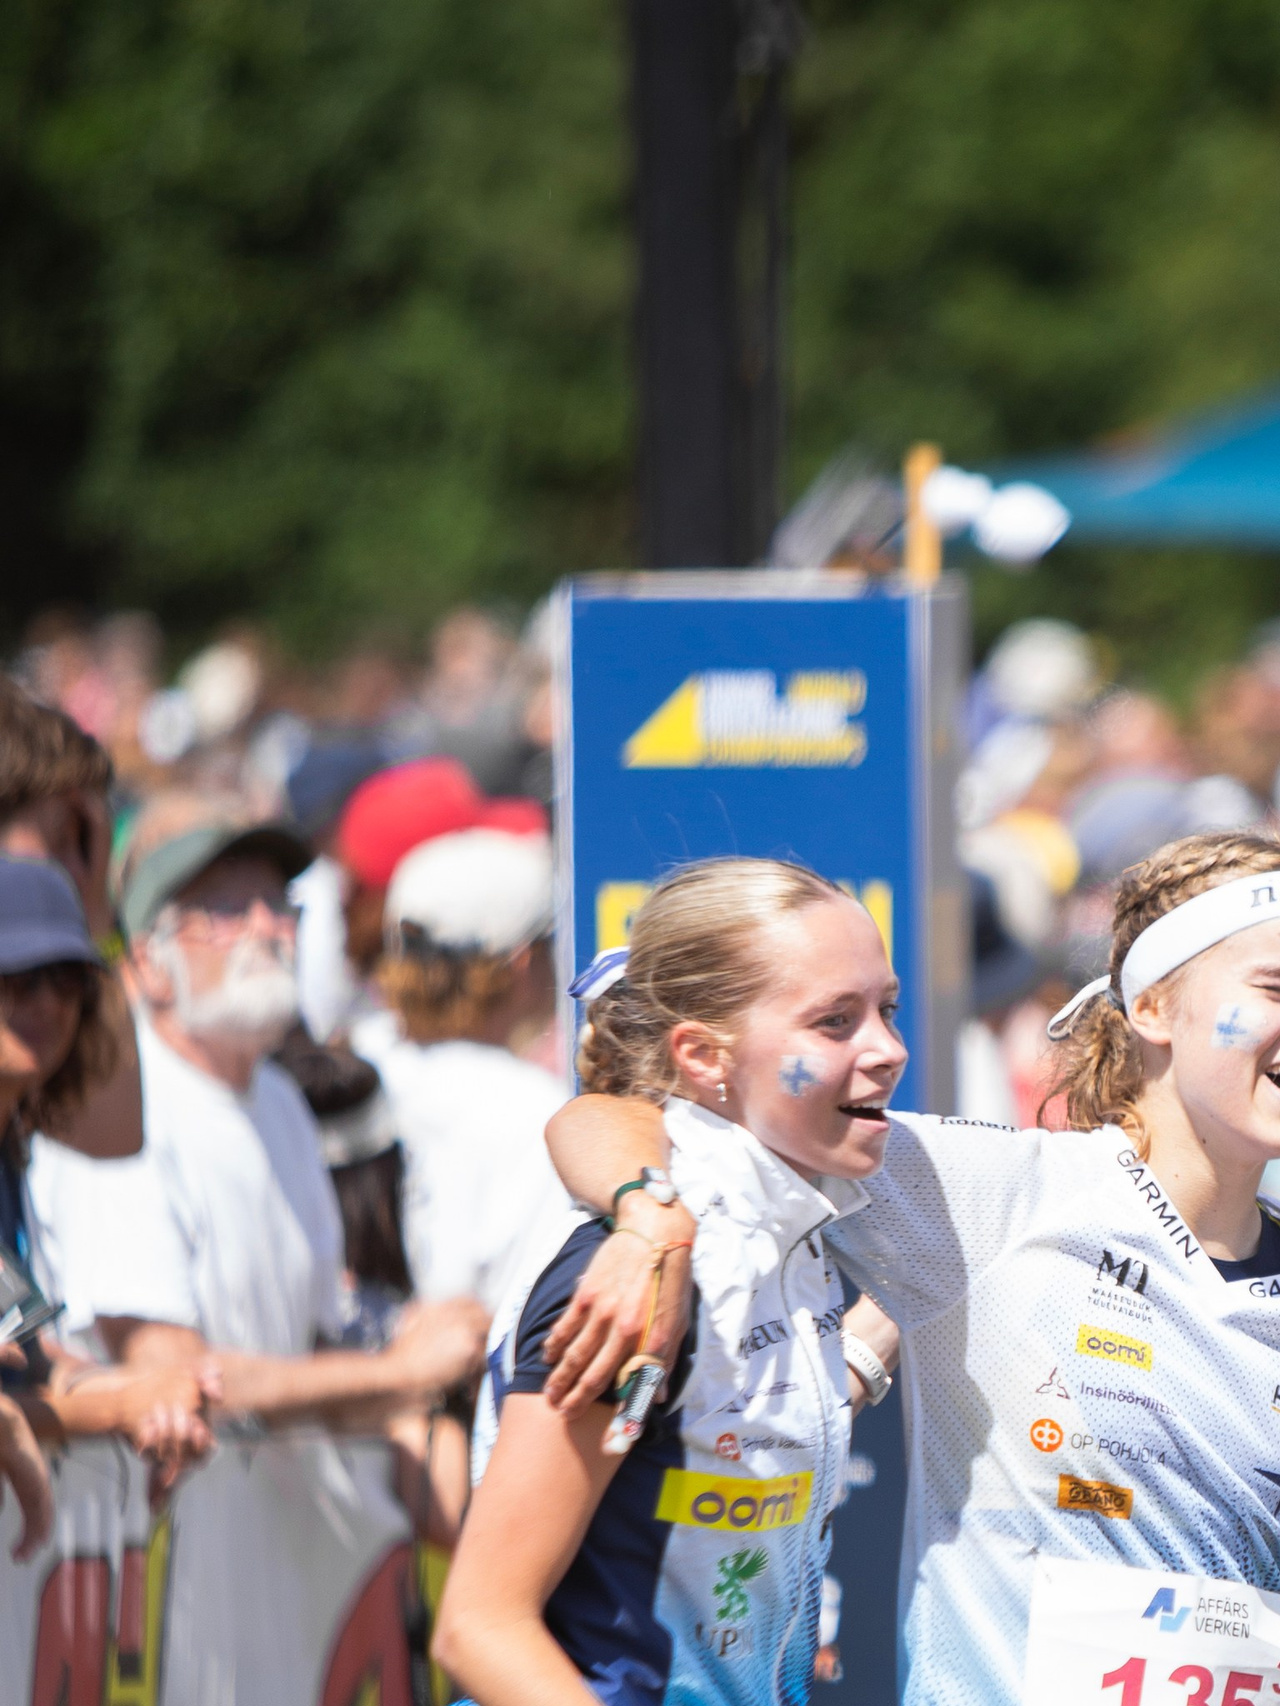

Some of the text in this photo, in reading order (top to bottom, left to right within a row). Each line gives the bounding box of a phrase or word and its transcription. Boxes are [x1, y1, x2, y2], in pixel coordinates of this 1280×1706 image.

[1097, 1248, 1149, 1296] MT
[1087, 1335, 1146, 1362] oomi
[1070, 1433, 1094, 1451] OP
[691, 1476, 798, 1528] oomi
[1197, 1597, 1249, 1619] AFFÄRS
[1194, 1616, 1250, 1639] VERKEN
